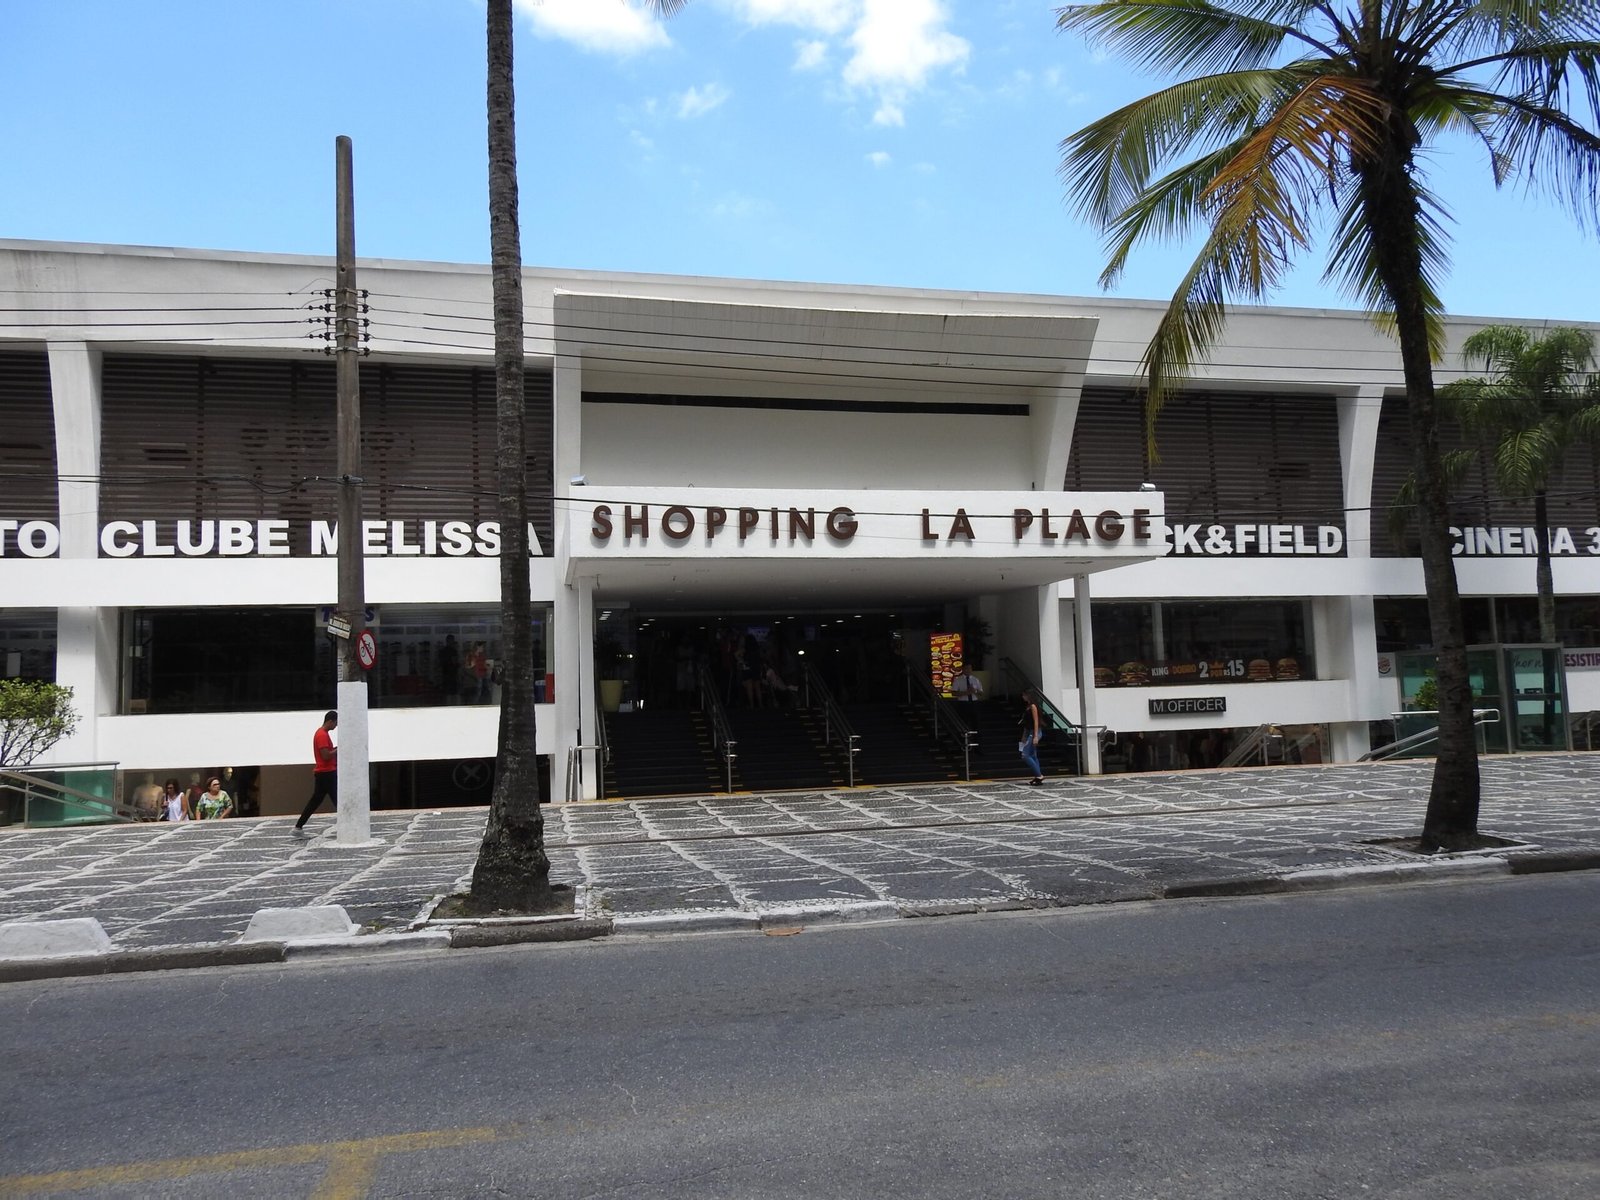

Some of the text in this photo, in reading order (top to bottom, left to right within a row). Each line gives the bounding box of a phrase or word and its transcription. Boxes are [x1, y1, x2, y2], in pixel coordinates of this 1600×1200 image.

[592, 505, 1151, 541] SHOPPING LA PLAGE
[101, 520, 290, 557] CLUBE
[1165, 524, 1343, 554] K&FIELD
[1152, 666, 1169, 676] KING
[1199, 661, 1209, 678] 2
[1153, 699, 1224, 713] M OFFICER
